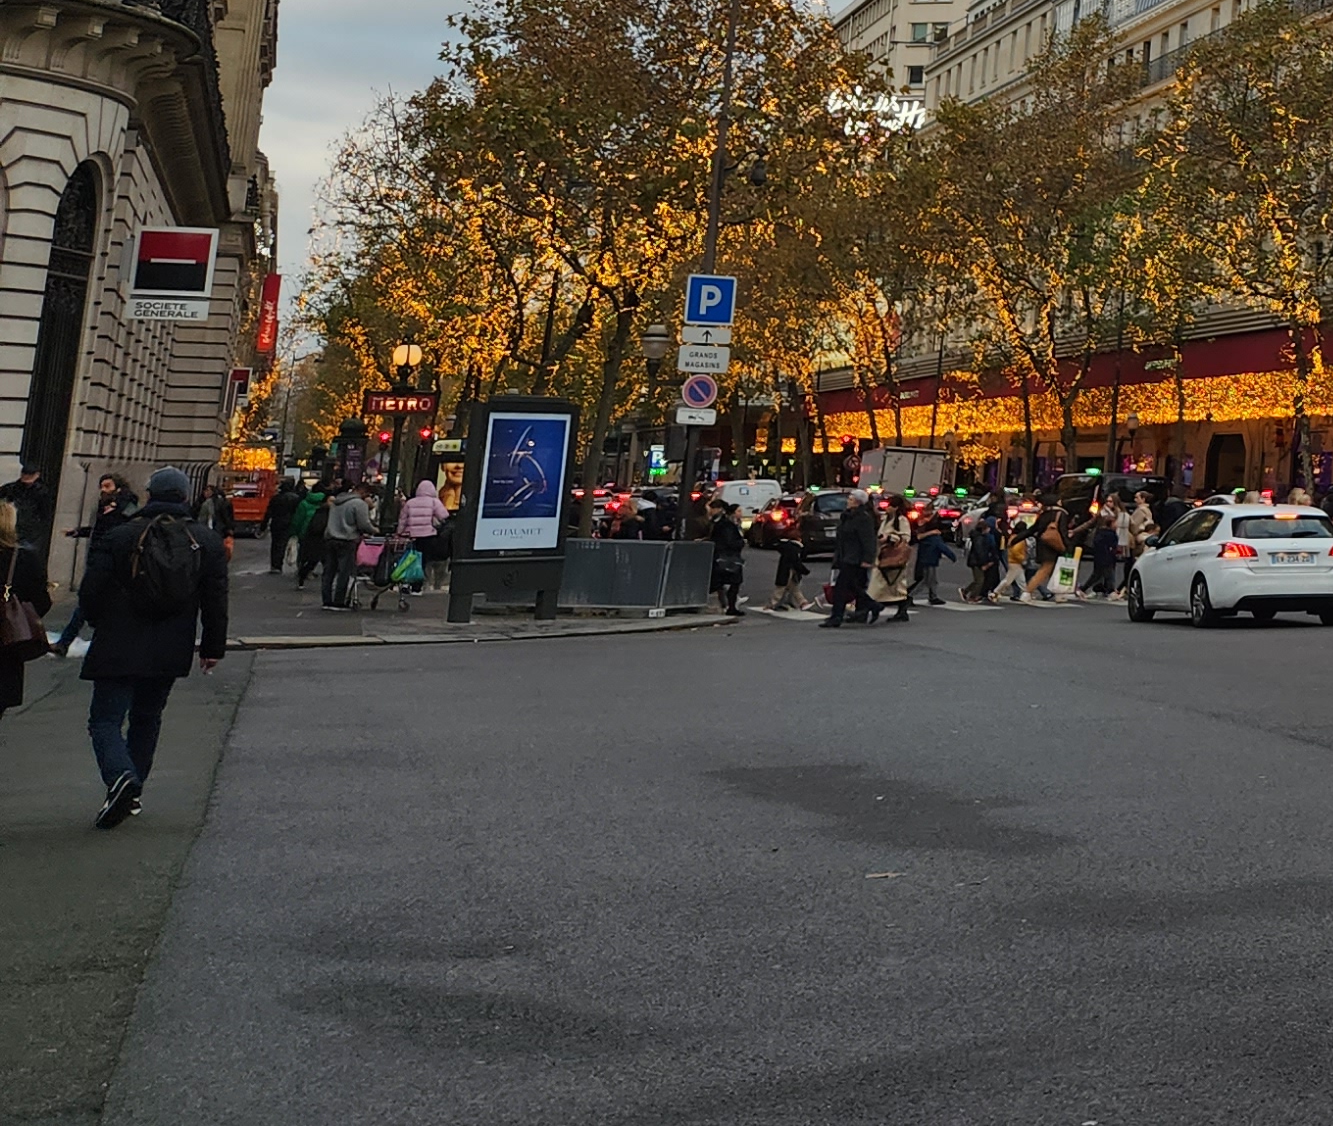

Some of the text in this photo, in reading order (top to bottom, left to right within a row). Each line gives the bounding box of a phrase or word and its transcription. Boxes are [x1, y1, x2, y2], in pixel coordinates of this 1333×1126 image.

[699, 284, 722, 315] P
[135, 301, 188, 310] SOCIETE
[134, 309, 199, 318] GENERALE
[689, 351, 718, 359] GRANDS
[685, 361, 721, 369] MAGASINS
[371, 397, 432, 411] METRO
[492, 527, 543, 536] CHAUMET
